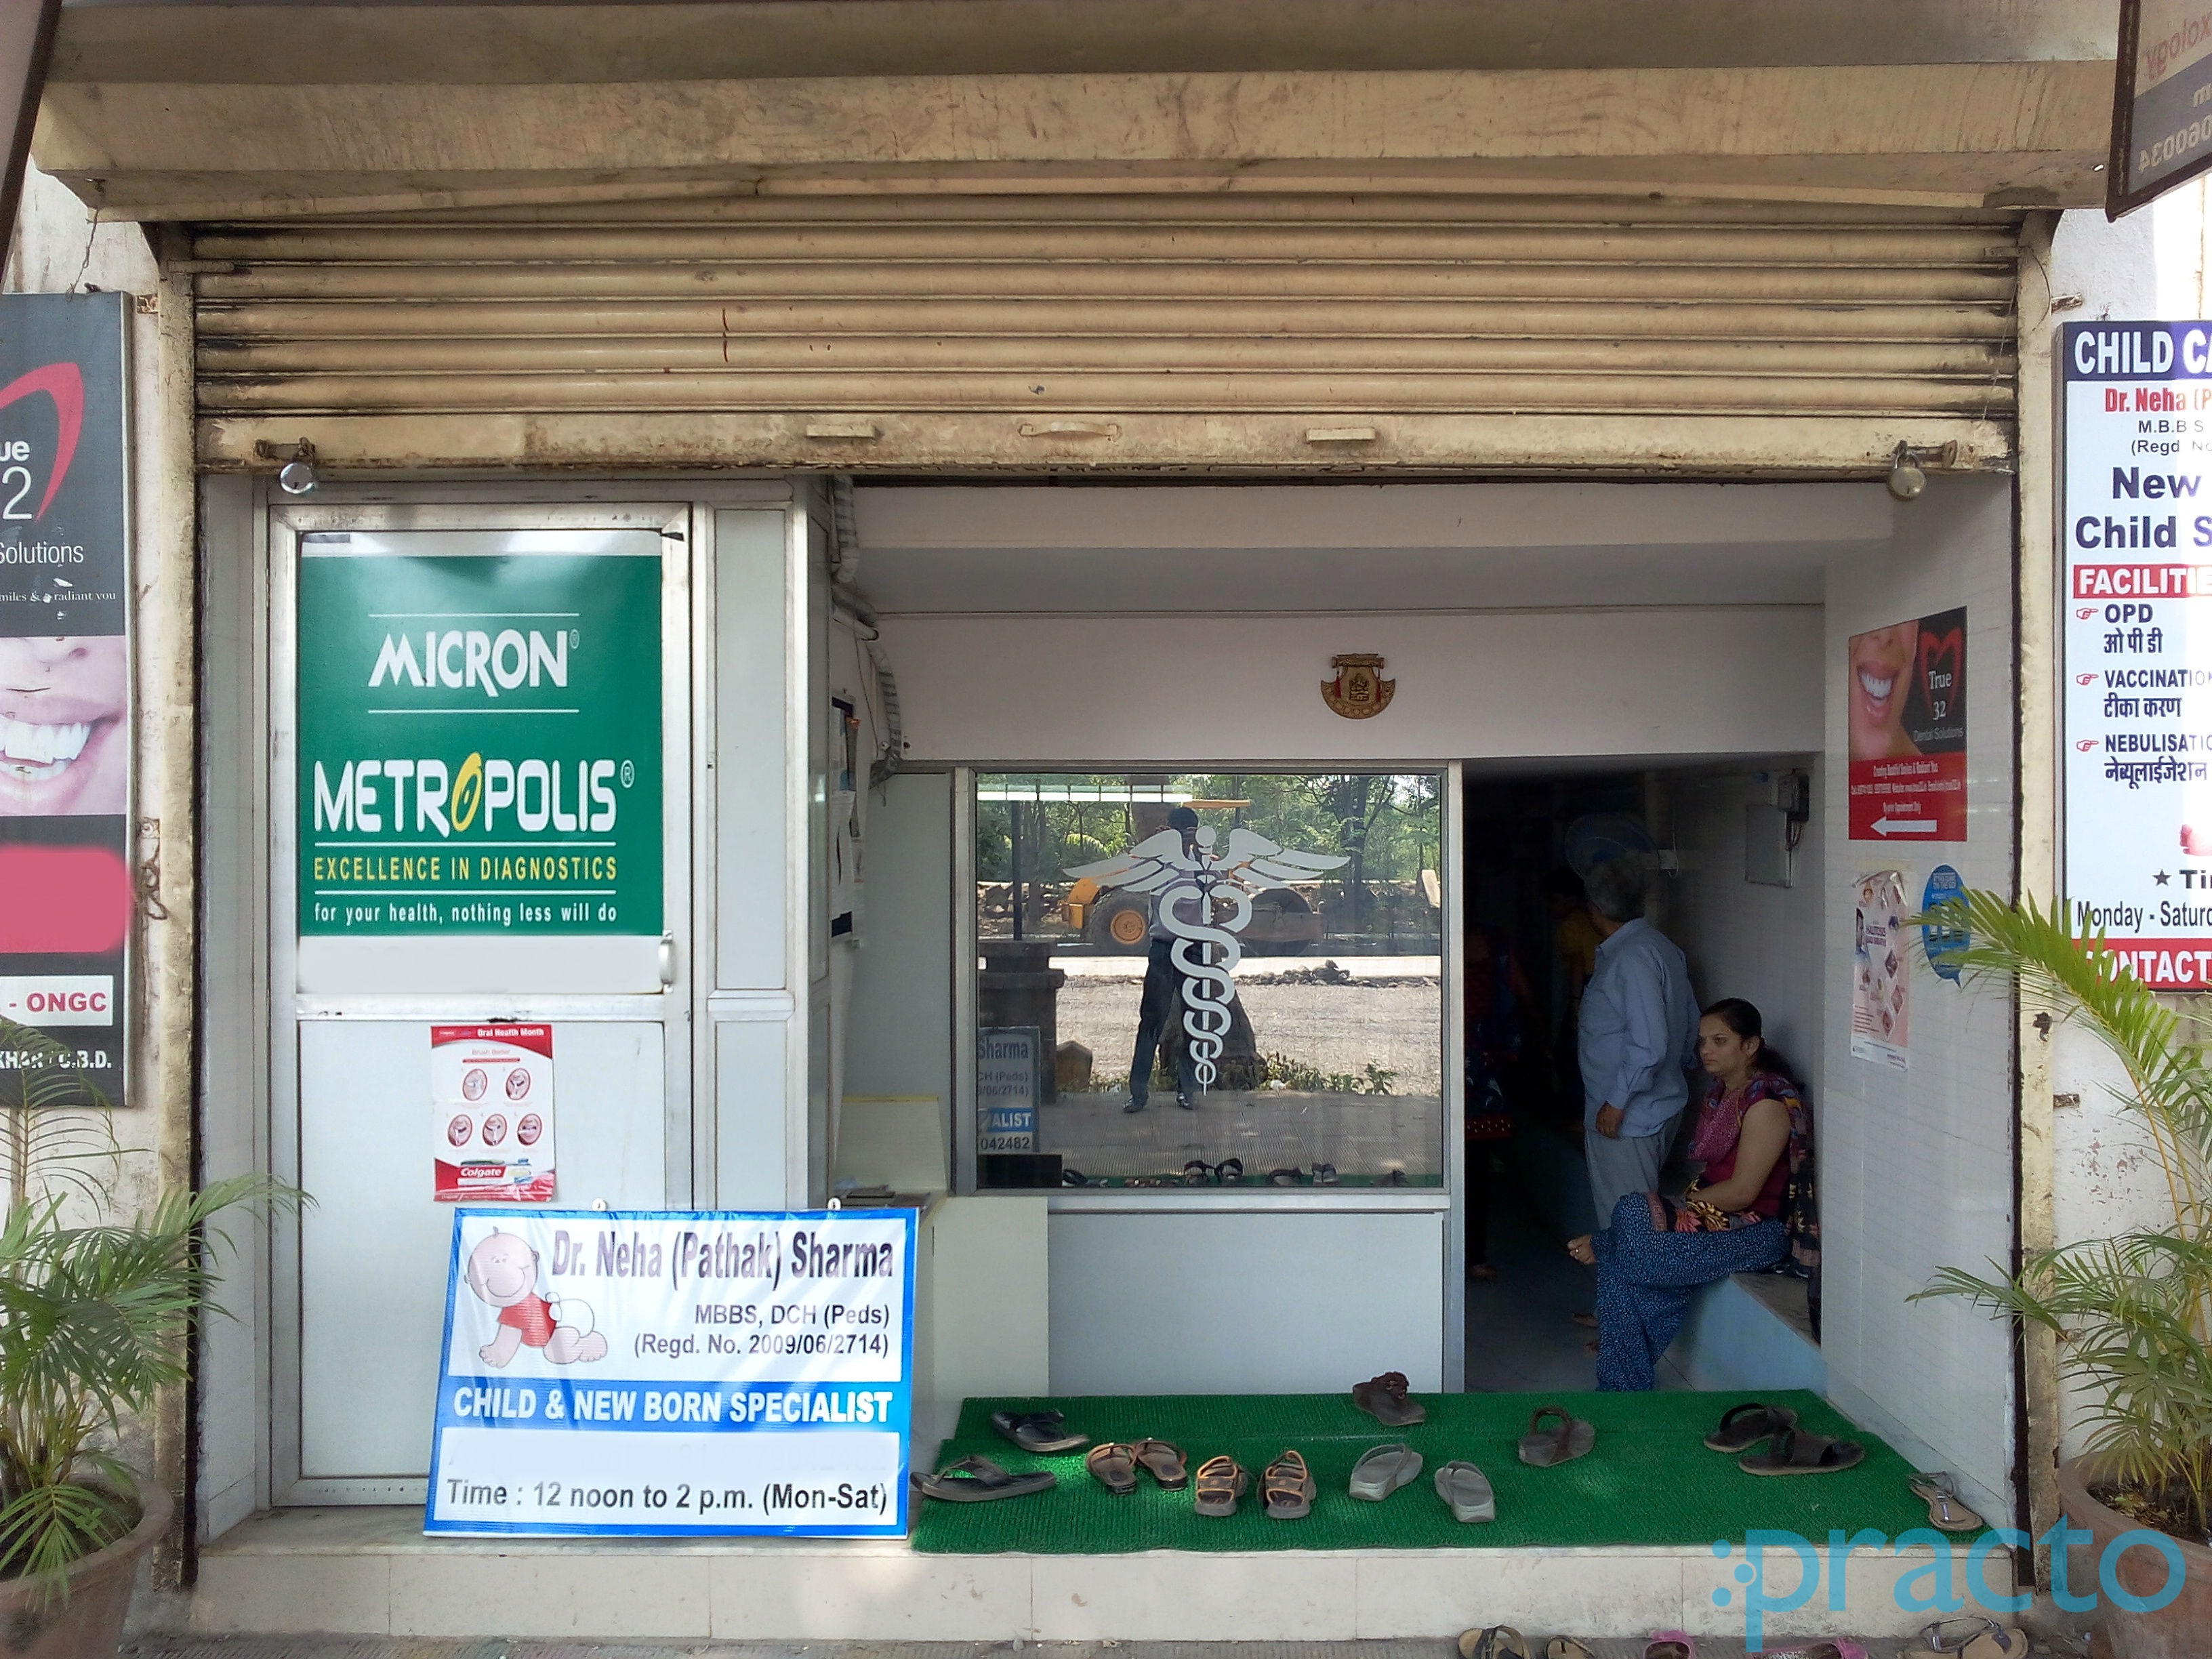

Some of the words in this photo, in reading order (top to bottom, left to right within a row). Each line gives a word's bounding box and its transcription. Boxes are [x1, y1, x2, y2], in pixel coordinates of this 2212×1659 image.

[2074, 331, 2174, 374] CHILD
[2183, 329, 2212, 374] C
[2105, 388, 2130, 412] Dr.
[2135, 387, 2186, 412] Neha
[2112, 466, 2203, 499] New
[2075, 515, 2177, 549] Child
[54, 590, 94, 602] radiant
[2104, 603, 2154, 623] OPD
[368, 629, 569, 697] MICRON
[1928, 670, 1952, 690] True
[1933, 700, 1946, 720] 32
[2103, 692, 2140, 718] टीका
[2143, 697, 2182, 718] करण
[314, 752, 617, 838] METROPOLIS
[314, 857, 441, 880] EXCELLENCE
[451, 857, 469, 880] IN
[480, 857, 617, 880] DIAGNOSTICS
[2179, 869, 2212, 889] Ti
[314, 903, 336, 922] for
[346, 907, 380, 927] your
[389, 903, 443, 924] health,
[451, 903, 512, 927] nothing
[519, 903, 552, 922] less
[561, 903, 590, 922] will
[598, 903, 617, 922] do
[2077, 900, 2144, 934] Monday
[2086, 950, 2212, 983] ONTACT
[26, 992, 107, 1012] ONGC
[477, 1027, 493, 1038] Oral
[494, 1027, 519, 1037] Health
[520, 1027, 545, 1037] Month
[978, 1038, 1029, 1060] Sharma
[980, 1136, 1030, 1150] 042482
[460, 1167, 502, 1177] Colgate
[552, 1231, 586, 1277] Dr.
[596, 1231, 662, 1278] Neha
[672, 1231, 781, 1291] (Pathak)
[792, 1231, 893, 1279] Sharma
[695, 1304, 763, 1328] MBBS,
[771, 1304, 817, 1324] DCH
[824, 1303, 890, 1328] (Peds)
[634, 1333, 700, 1357] (Regd.
[708, 1334, 741, 1355] No.
[748, 1334, 889, 1358] 2009/06/2714)
[453, 1387, 536, 1419] CHILD
[544, 1389, 565, 1420] &
[574, 1389, 637, 1421] NEW
[643, 1390, 722, 1422] BORN
[729, 1391, 893, 1422] SPECIALIST
[447, 1479, 508, 1507] Time
[533, 1481, 561, 1507] 12
[570, 1488, 634, 1509] noon
[643, 1483, 666, 1509] to
[676, 1483, 691, 1509] 2
[699, 1488, 754, 1515] p.m.
[762, 1482, 887, 1515] (Mon-Sat)
